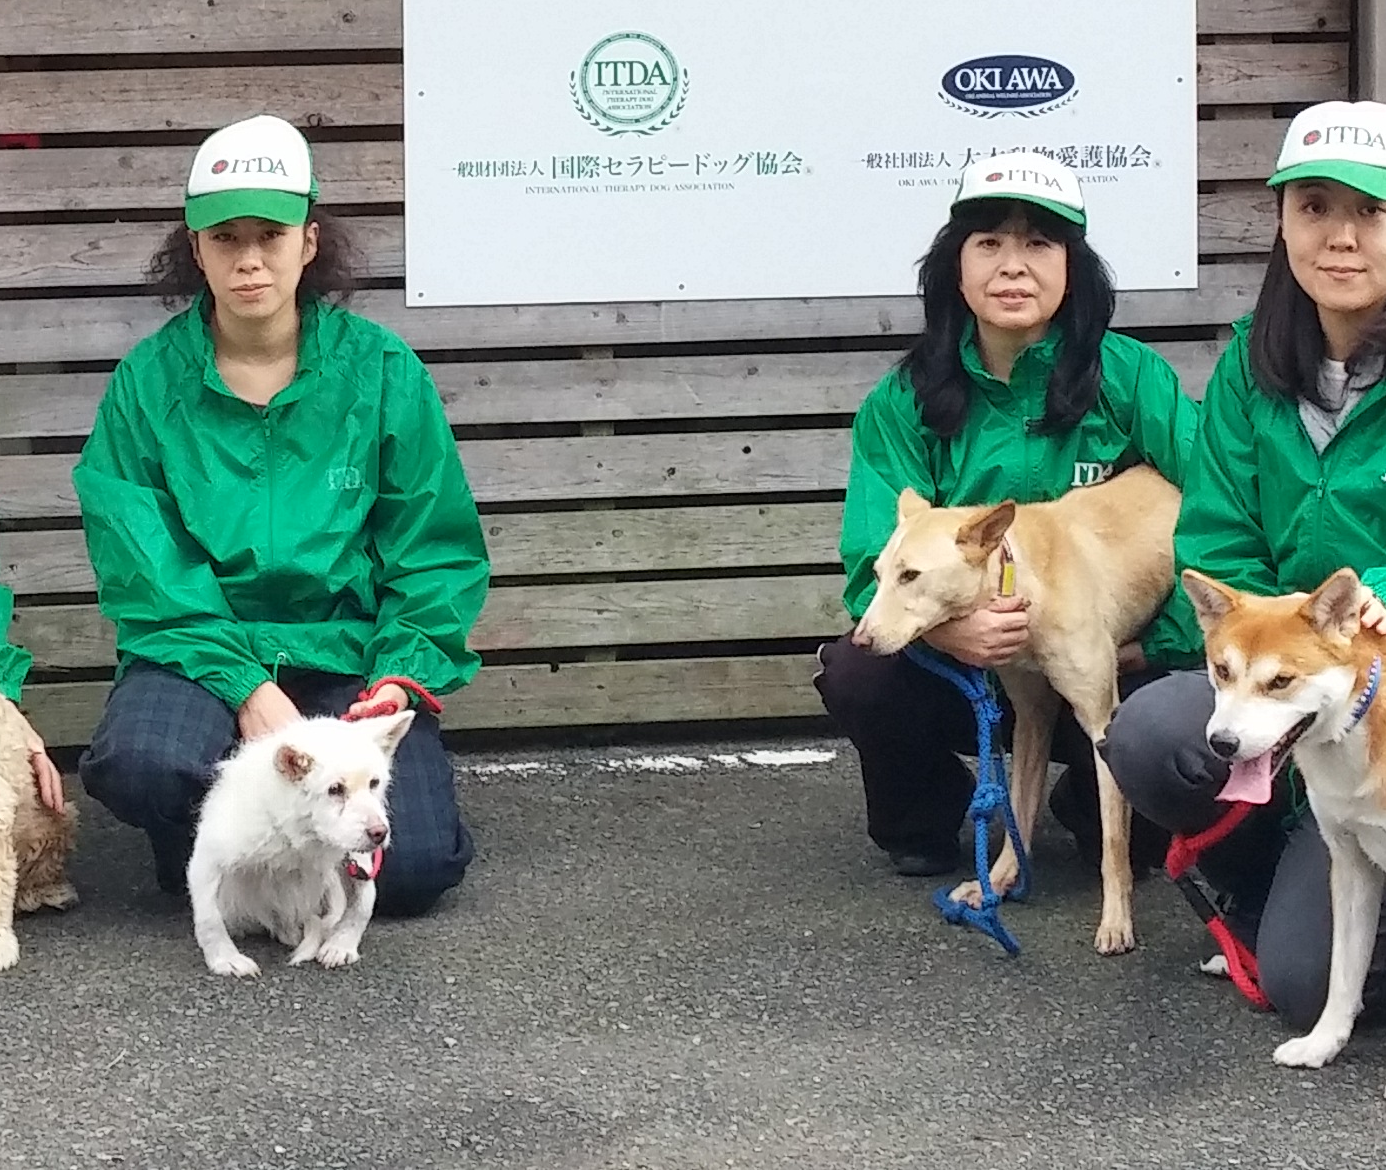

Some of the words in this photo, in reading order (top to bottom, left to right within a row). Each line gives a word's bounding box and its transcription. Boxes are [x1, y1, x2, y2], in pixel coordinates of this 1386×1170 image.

[594, 60, 671, 87] ITDA
[954, 68, 1003, 92] OKI
[1005, 67, 1064, 91] AWA
[1324, 126, 1386, 150] ITDA
[230, 156, 289, 177] ITDA
[443, 159, 545, 178] 一般財団法人
[551, 151, 803, 180] 国際セラピードッグ協会
[854, 151, 952, 169] 一般社団法人
[1008, 169, 1063, 192] ITDA
